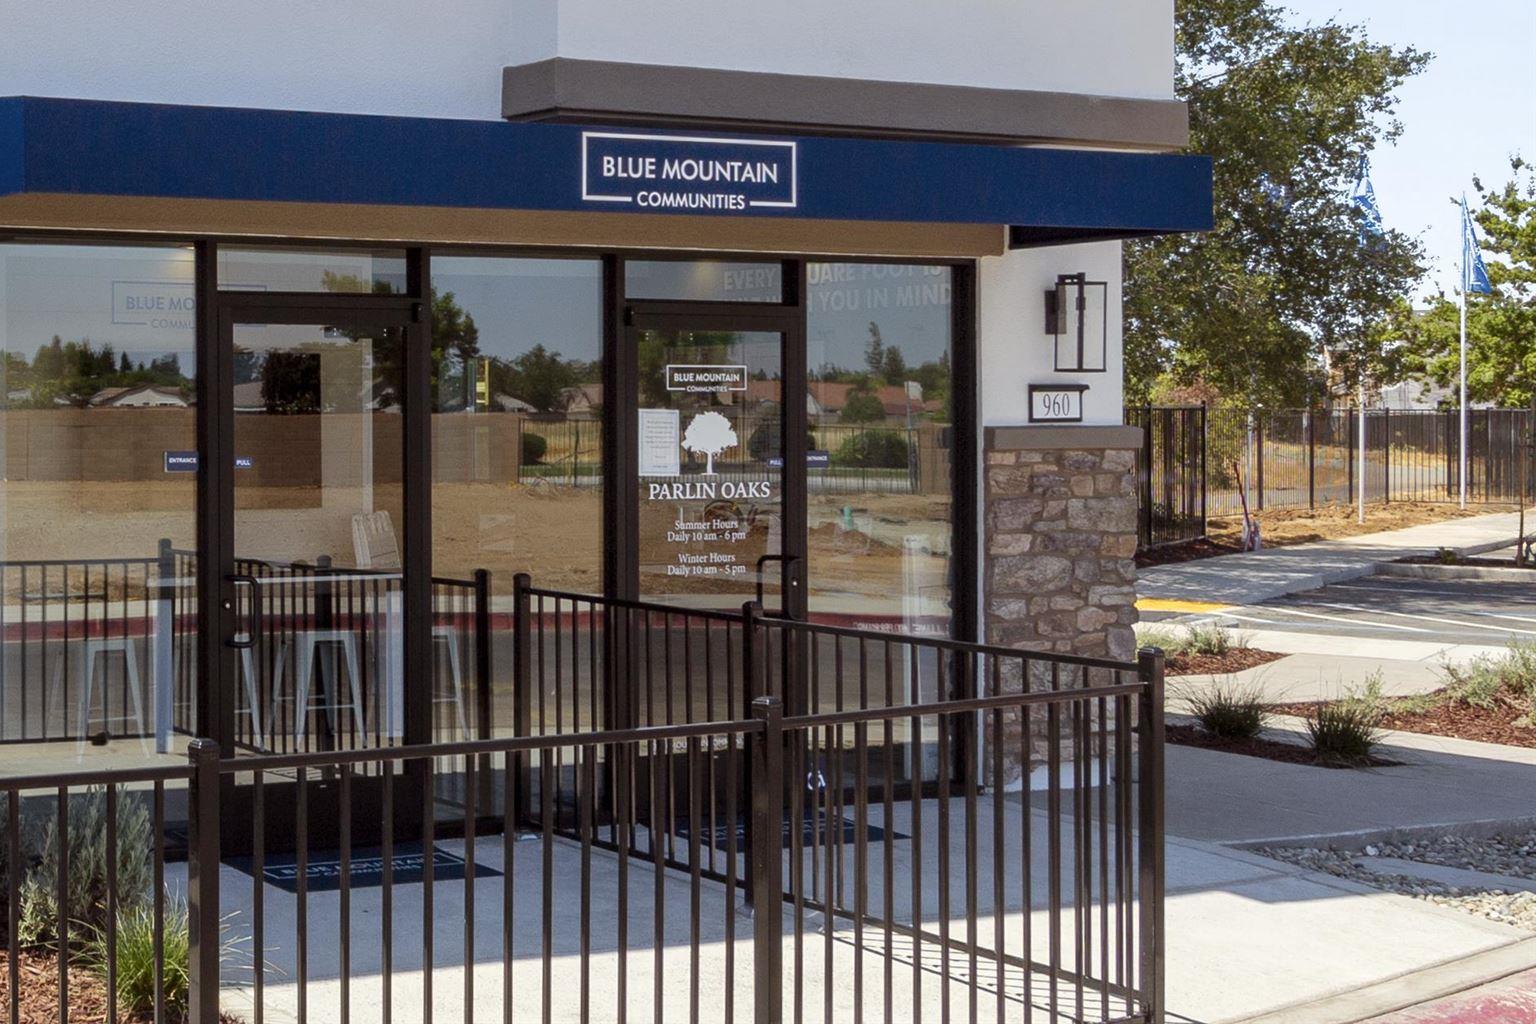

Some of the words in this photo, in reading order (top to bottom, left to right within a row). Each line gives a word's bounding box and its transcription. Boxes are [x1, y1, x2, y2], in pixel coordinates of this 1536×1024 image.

[603, 156, 656, 178] BLUE
[662, 159, 778, 183] MOUNTAIN
[637, 191, 745, 209] COMMUNITIES
[724, 267, 776, 290] EVERY
[808, 263, 854, 285] UARE
[126, 296, 164, 311] BLUE
[819, 289, 859, 312] YOU
[866, 287, 888, 308] IN
[895, 283, 951, 307] MIND
[674, 373, 694, 382] BLUE
[696, 373, 740, 382] MOUNTAIN
[1043, 393, 1070, 416] 960
[649, 483, 716, 500] PARLIN
[721, 482, 771, 498] OAKS
[675, 520, 710, 530] Summer
[713, 519, 738, 529] Hours
[667, 532, 689, 544] Daily
[692, 532, 702, 541] 10
[725, 531, 730, 540] 6
[732, 532, 746, 543] pm
[678, 554, 707, 563] Winter
[710, 553, 735, 562] Hours
[667, 565, 689, 576] Daily
[692, 565, 702, 574] 10
[725, 564, 730, 574] 5
[732, 566, 746, 576] pm
